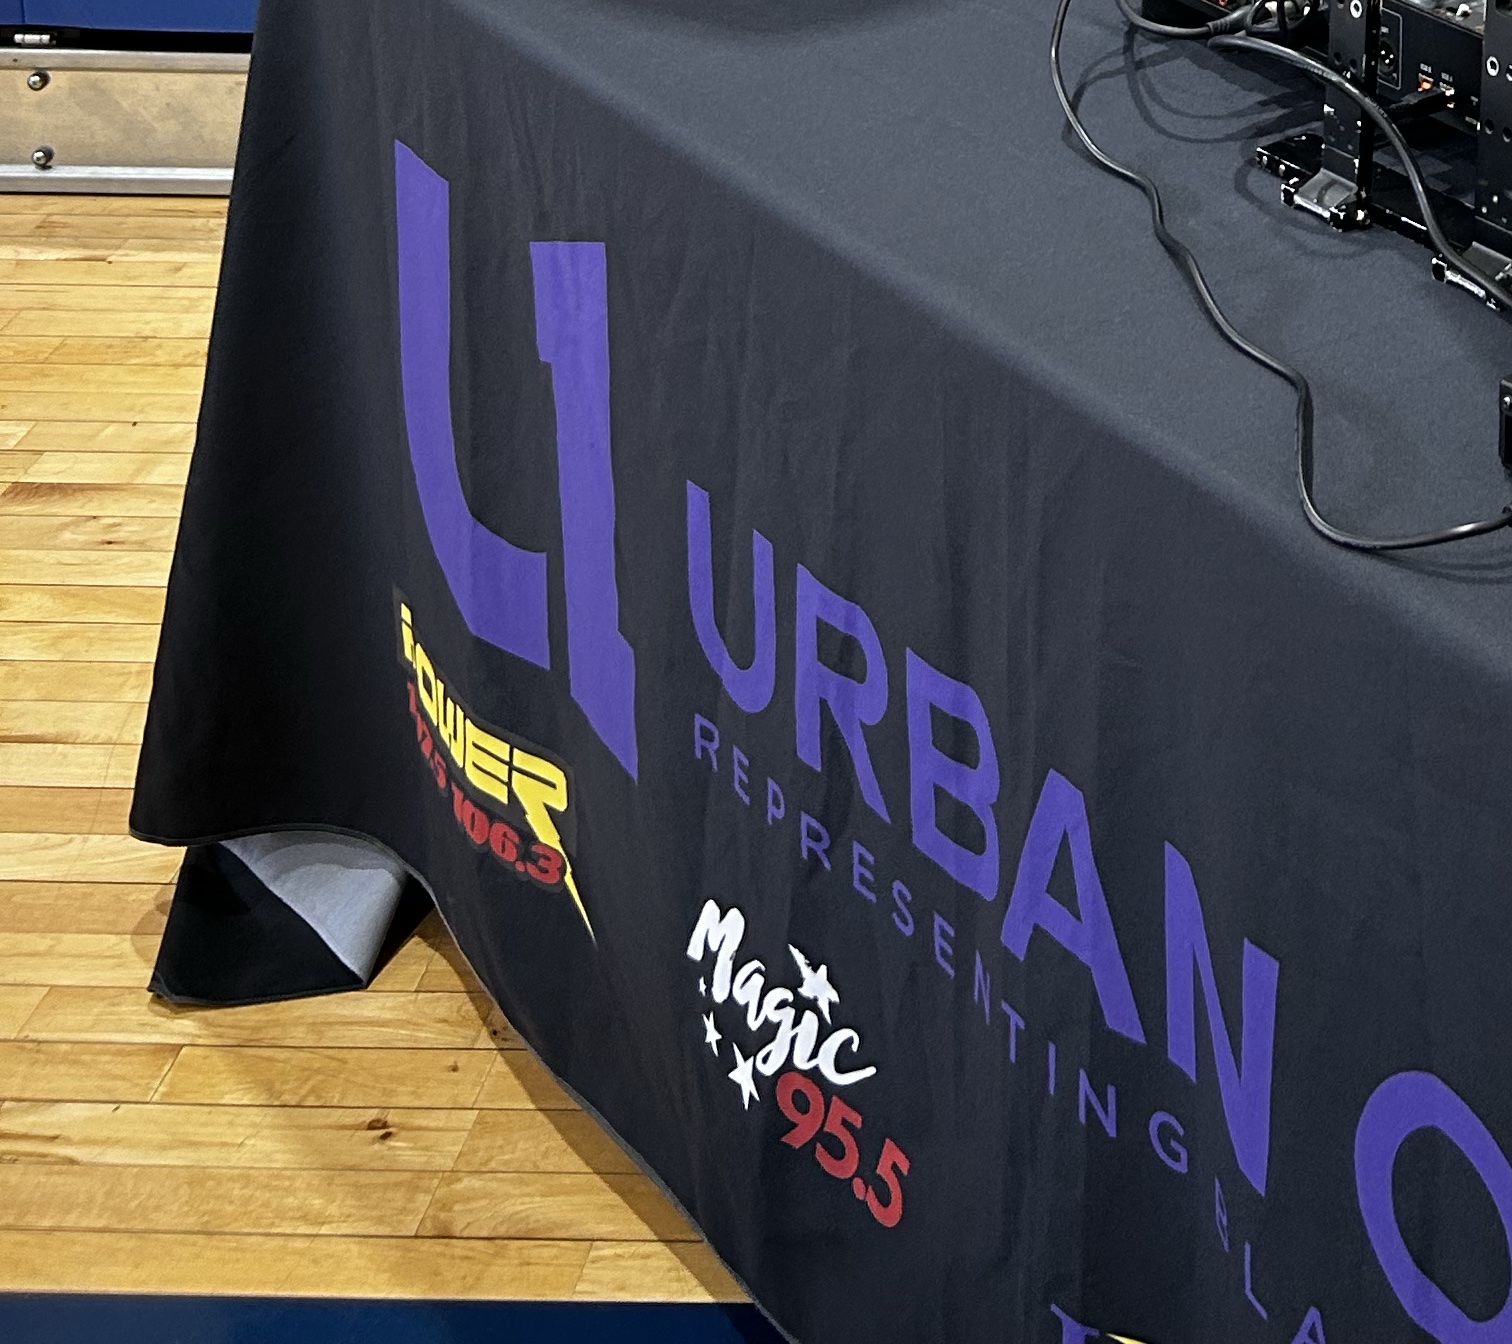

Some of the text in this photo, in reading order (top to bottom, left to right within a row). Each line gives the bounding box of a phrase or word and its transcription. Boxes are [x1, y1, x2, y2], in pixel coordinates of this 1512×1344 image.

[451, 782, 565, 886] 106.3
[686, 479, 1280, 1197] URBAN
[686, 899, 877, 1086] Magic
[693, 714, 1189, 1175] REPRESENTING
[776, 1071, 911, 1228] 95.5
